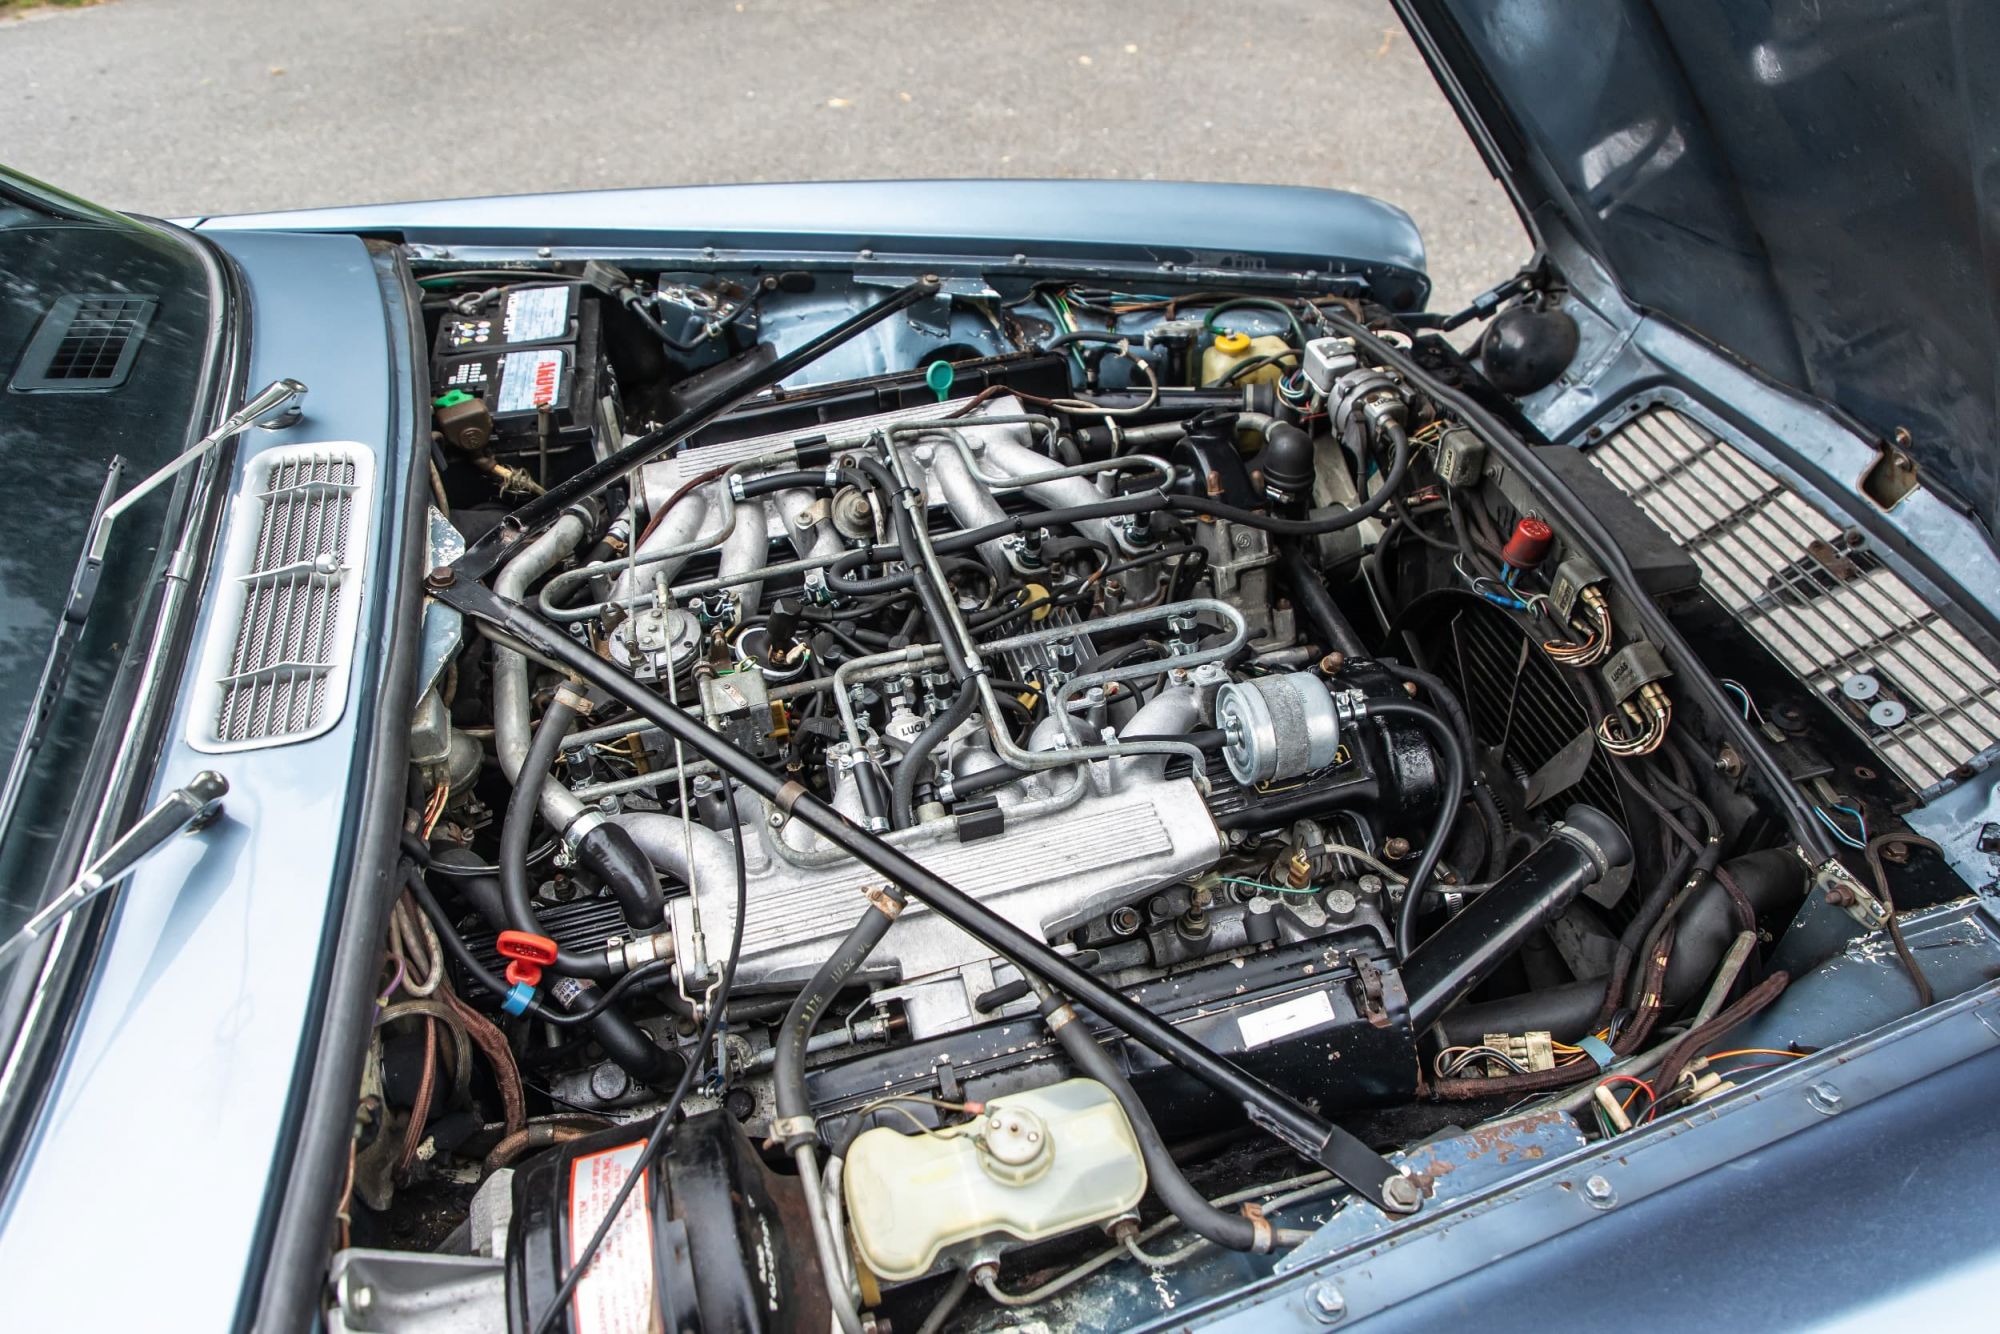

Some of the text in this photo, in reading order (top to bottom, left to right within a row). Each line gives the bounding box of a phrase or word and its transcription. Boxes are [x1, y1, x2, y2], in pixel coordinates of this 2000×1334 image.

[533, 361, 558, 406] AKUMA
[1610, 661, 1630, 682] LUCAS
[901, 720, 926, 736] LUCA
